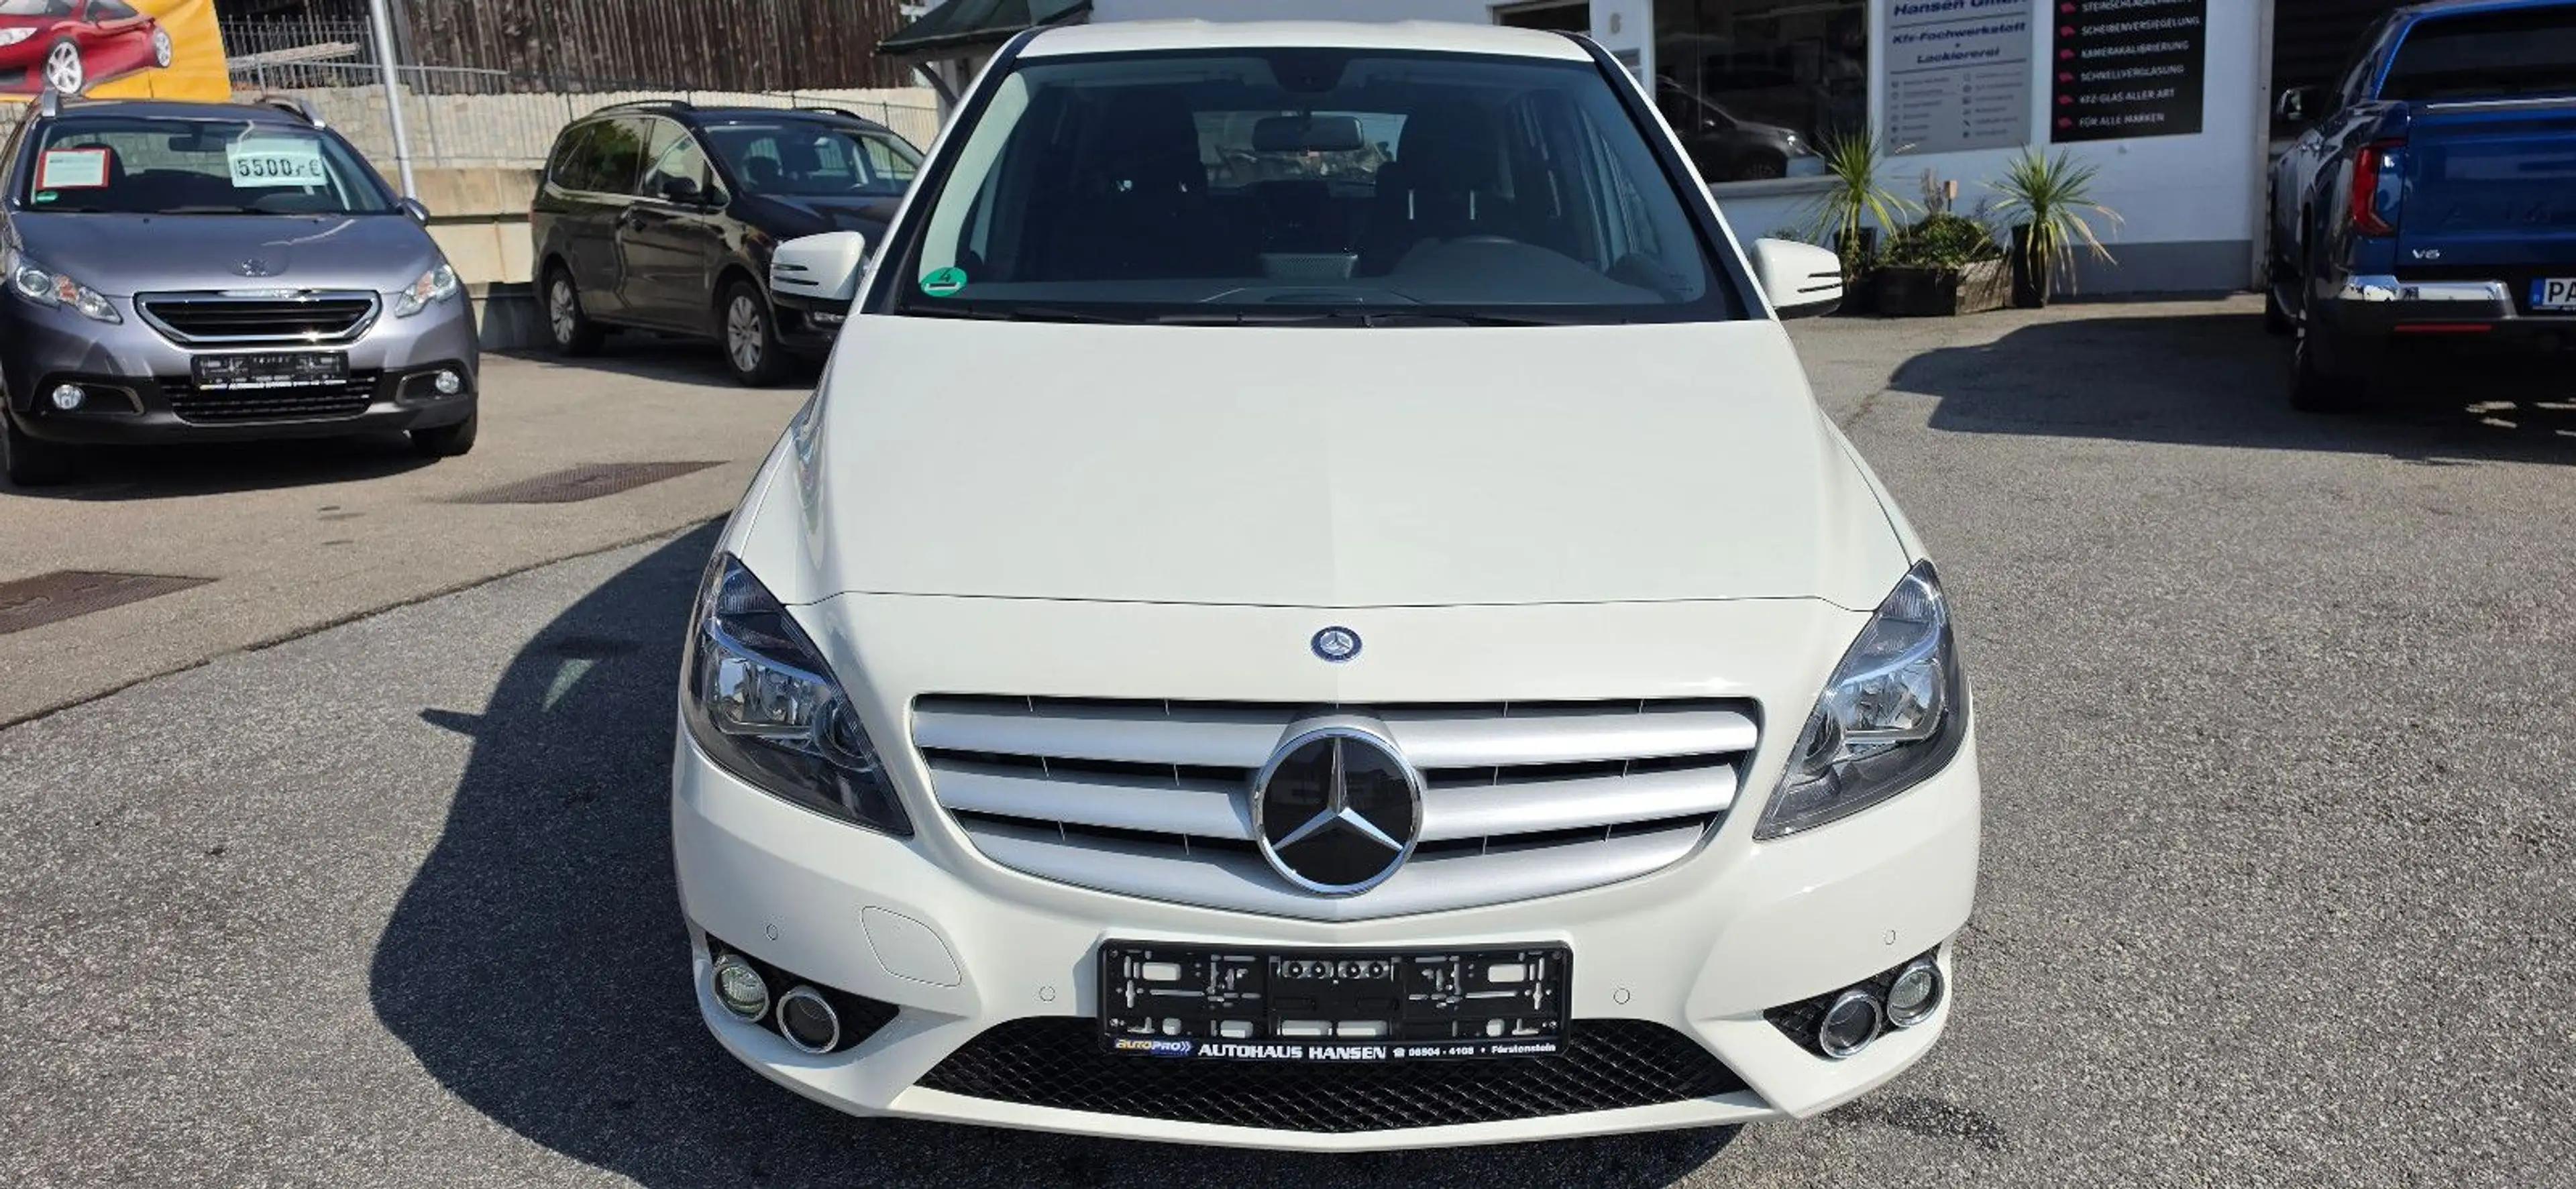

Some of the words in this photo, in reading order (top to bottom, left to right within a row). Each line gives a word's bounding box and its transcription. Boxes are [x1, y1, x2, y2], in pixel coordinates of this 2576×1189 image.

[1894, 0, 1964, 16] Hansen
[2125, 90, 2155, 101] ALLER
[2157, 88, 2175, 99] ART
[2100, 115, 2121, 126] ALLE
[2123, 112, 2165, 124] MARKEN
[2412, 248, 2440, 259] V6
[938, 269, 952, 282] 4
[2548, 281, 2576, 303] PA
[1197, 1043, 1302, 1058] AUTOHAUS
[1309, 1045, 1386, 1060] HANSEN
[1448, 1046, 1474, 1055] 4108
